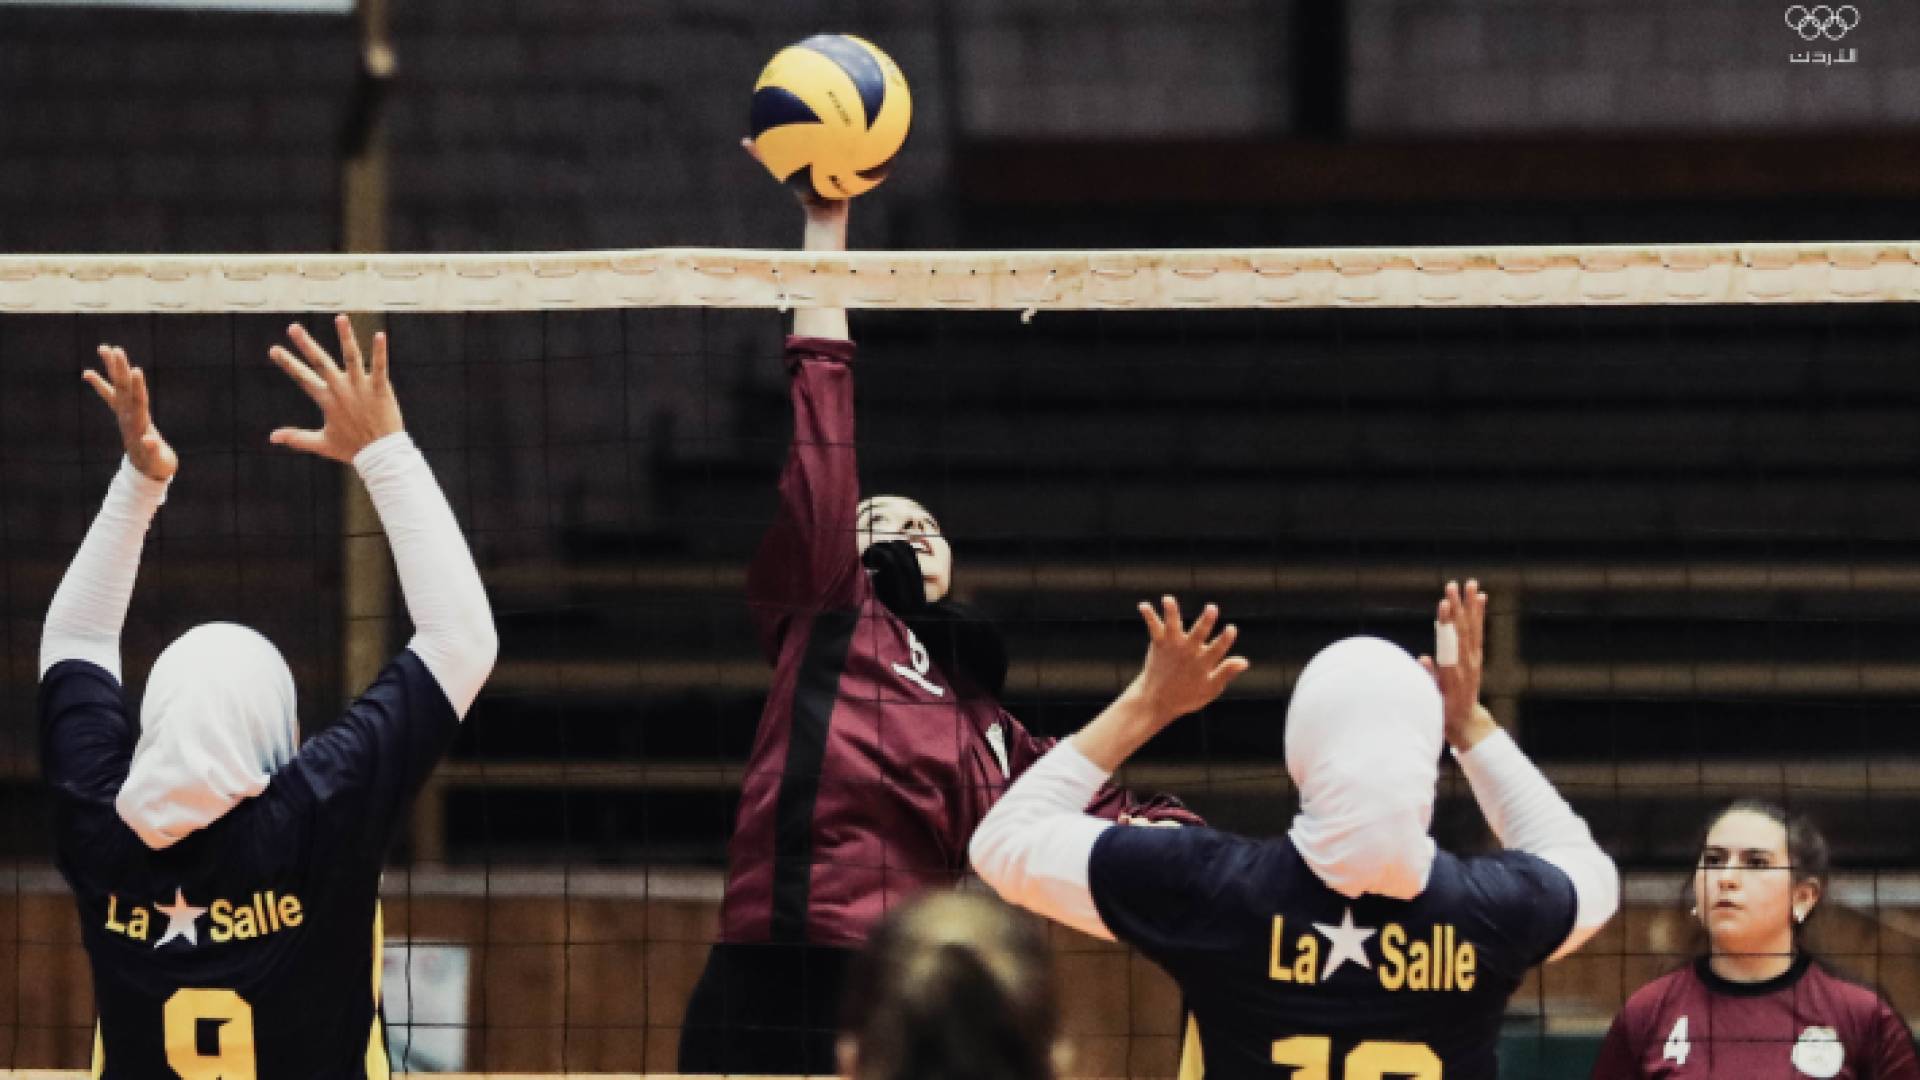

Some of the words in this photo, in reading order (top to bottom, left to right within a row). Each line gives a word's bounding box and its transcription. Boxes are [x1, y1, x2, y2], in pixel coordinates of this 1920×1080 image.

[105, 893, 150, 941] La
[209, 890, 303, 942] Salle
[1268, 914, 1318, 984] La
[1378, 922, 1477, 991] Salle
[163, 987, 258, 1080] 9
[1663, 1015, 1690, 1065] 4
